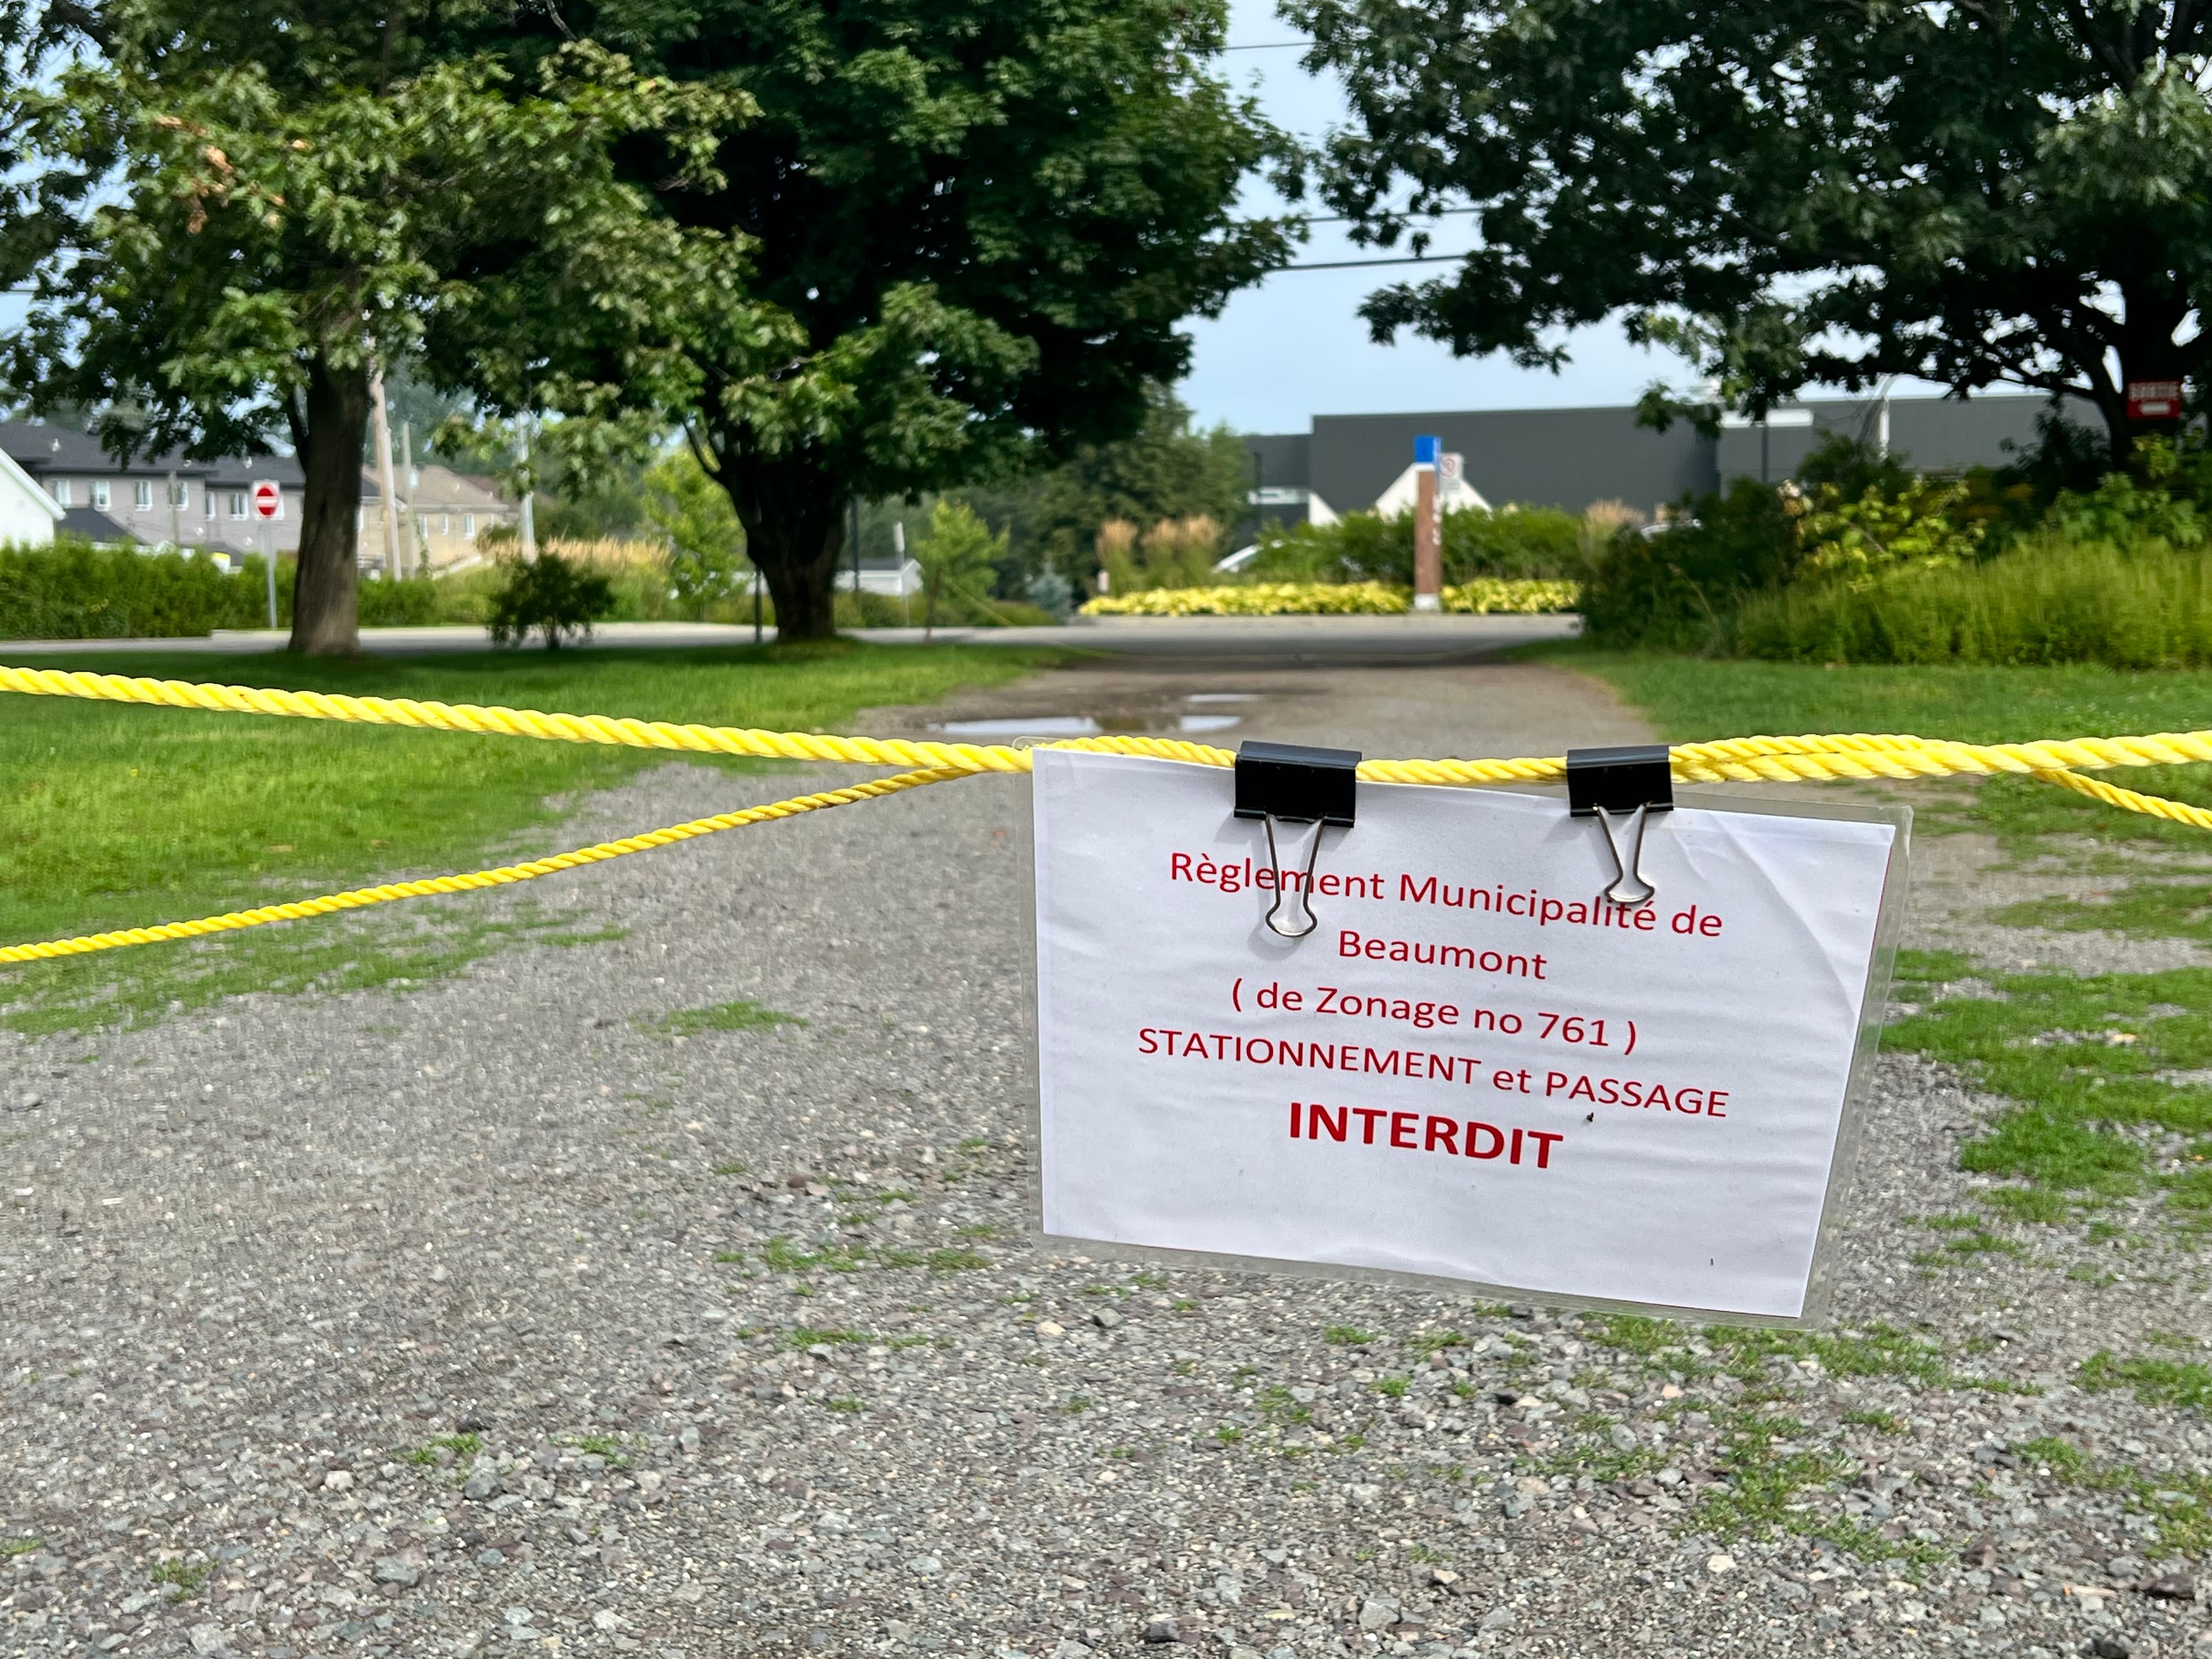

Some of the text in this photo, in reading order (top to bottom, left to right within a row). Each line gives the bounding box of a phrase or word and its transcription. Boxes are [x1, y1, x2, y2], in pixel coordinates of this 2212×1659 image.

[1170, 851, 1723, 937] Règlement Municipalité de
[1338, 929, 1547, 980] Beaumont
[1256, 981, 1304, 1012] de
[1316, 986, 1460, 1029] Zonage
[1474, 1008, 1523, 1035] no
[1538, 1012, 1608, 1047] 761
[1138, 1027, 1729, 1118] STATIONNEMENT et PASSAGE
[1289, 1101, 1565, 1169] INTERDIT
